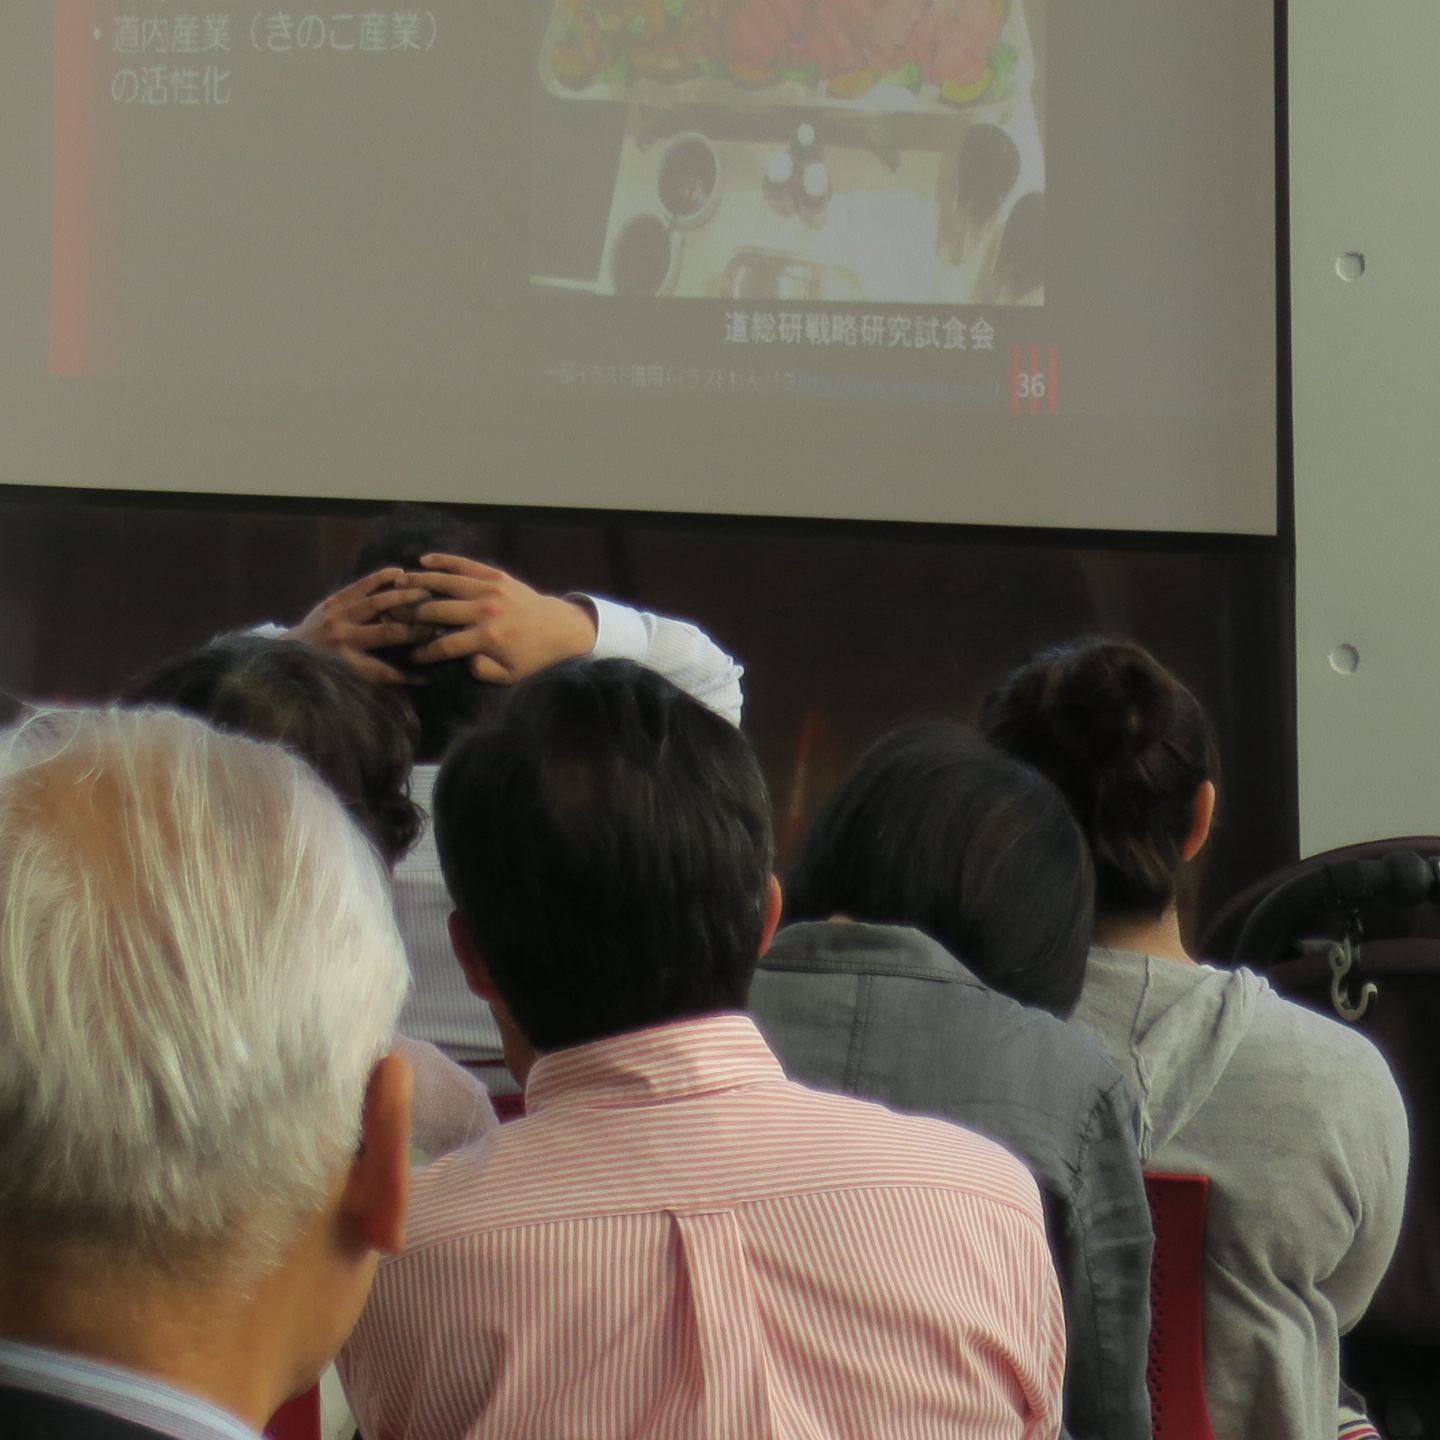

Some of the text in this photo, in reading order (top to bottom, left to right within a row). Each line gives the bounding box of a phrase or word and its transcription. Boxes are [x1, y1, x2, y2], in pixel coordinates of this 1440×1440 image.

[110, 65, 232, 105] の活性化
[723, 310, 997, 351] 道総研戦略研究試食会
[1017, 372, 1047, 398] 36
